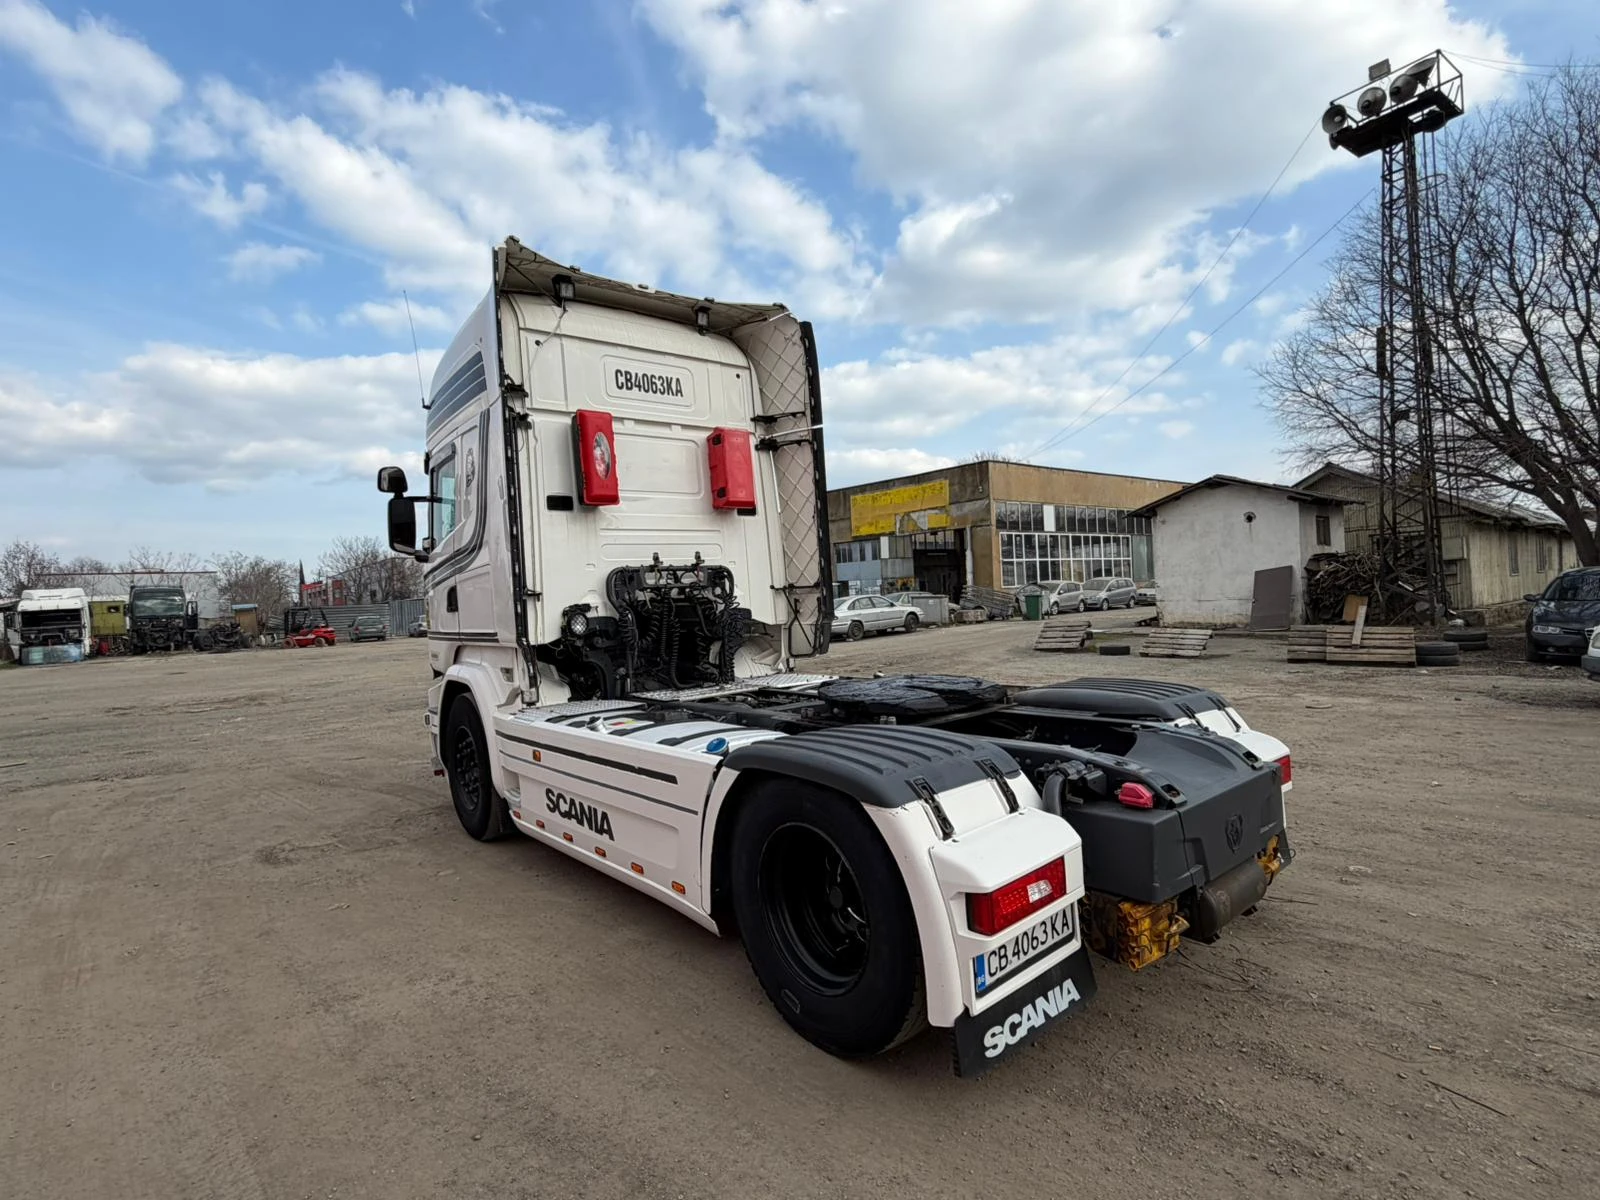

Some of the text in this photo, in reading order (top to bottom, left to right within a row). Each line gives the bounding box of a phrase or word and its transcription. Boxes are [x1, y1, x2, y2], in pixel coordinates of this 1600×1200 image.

[615, 369, 683, 397] CB4063KA
[545, 787, 615, 841] SCANIA
[984, 978, 1081, 1058] SCANIA
